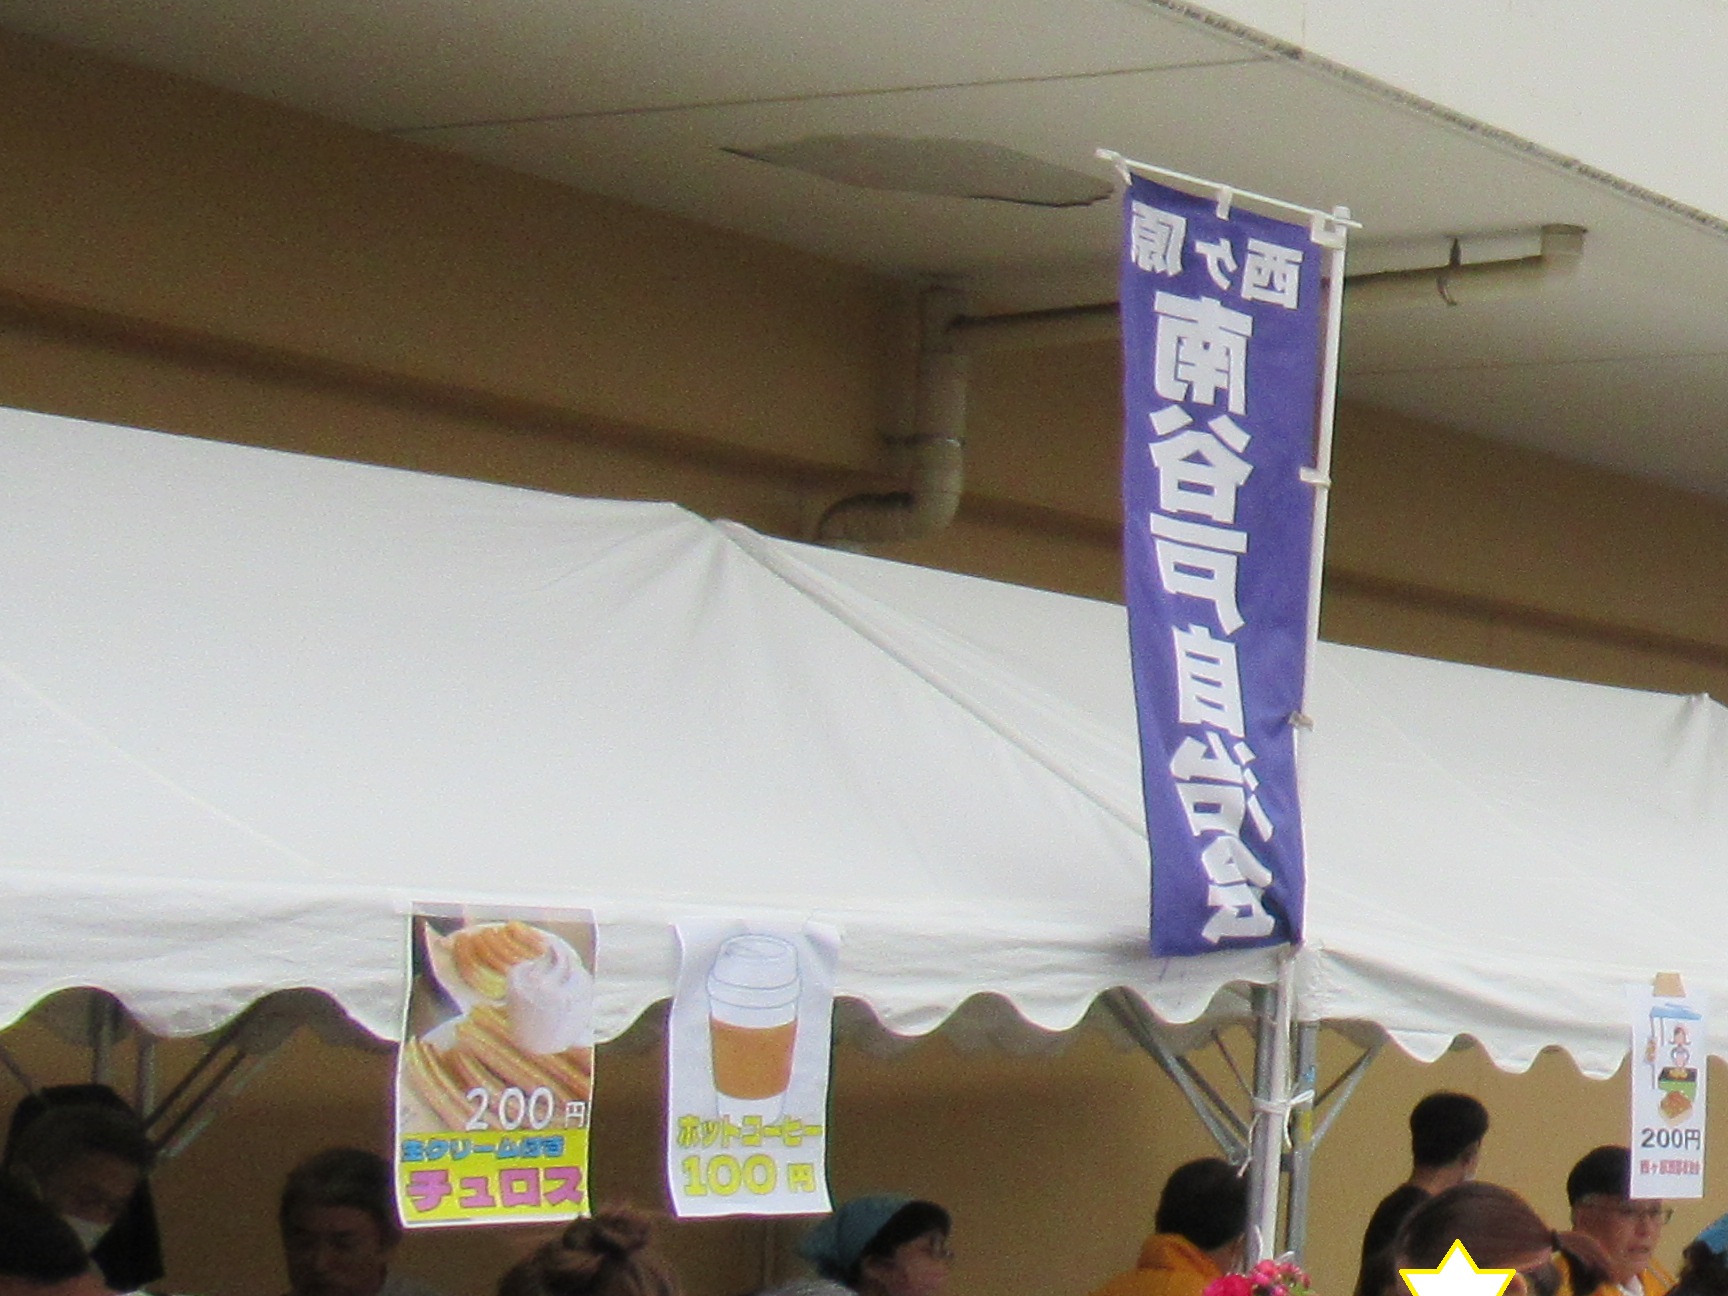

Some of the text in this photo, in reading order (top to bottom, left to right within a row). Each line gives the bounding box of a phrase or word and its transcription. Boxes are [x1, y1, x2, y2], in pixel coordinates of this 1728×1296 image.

[465, 1087, 588, 1132] 200円
[677, 1114, 823, 1149] ホットコーヒー
[1640, 1127, 1701, 1151] 200円
[405, 1165, 585, 1214] チュロス
[682, 1153, 817, 1198] 100円
